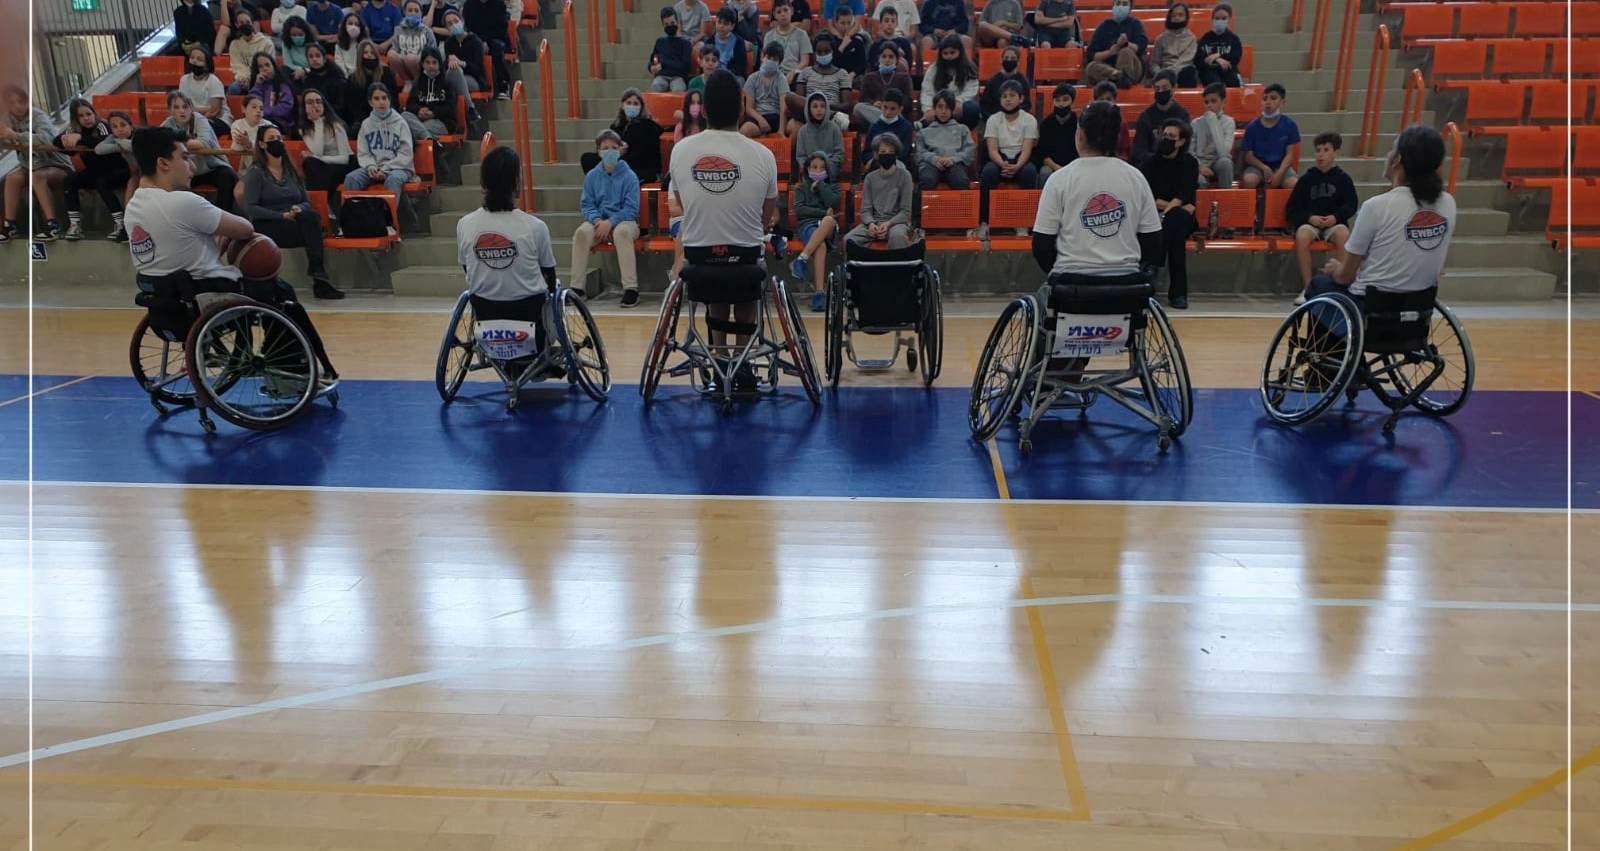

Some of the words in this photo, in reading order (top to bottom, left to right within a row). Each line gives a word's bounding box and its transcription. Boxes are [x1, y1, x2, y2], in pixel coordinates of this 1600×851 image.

[696, 171, 736, 181] EWBCO
[1086, 210, 1121, 226] EWBCO
[1411, 225, 1445, 238] EWBCO
[479, 248, 514, 258] EWBCO
